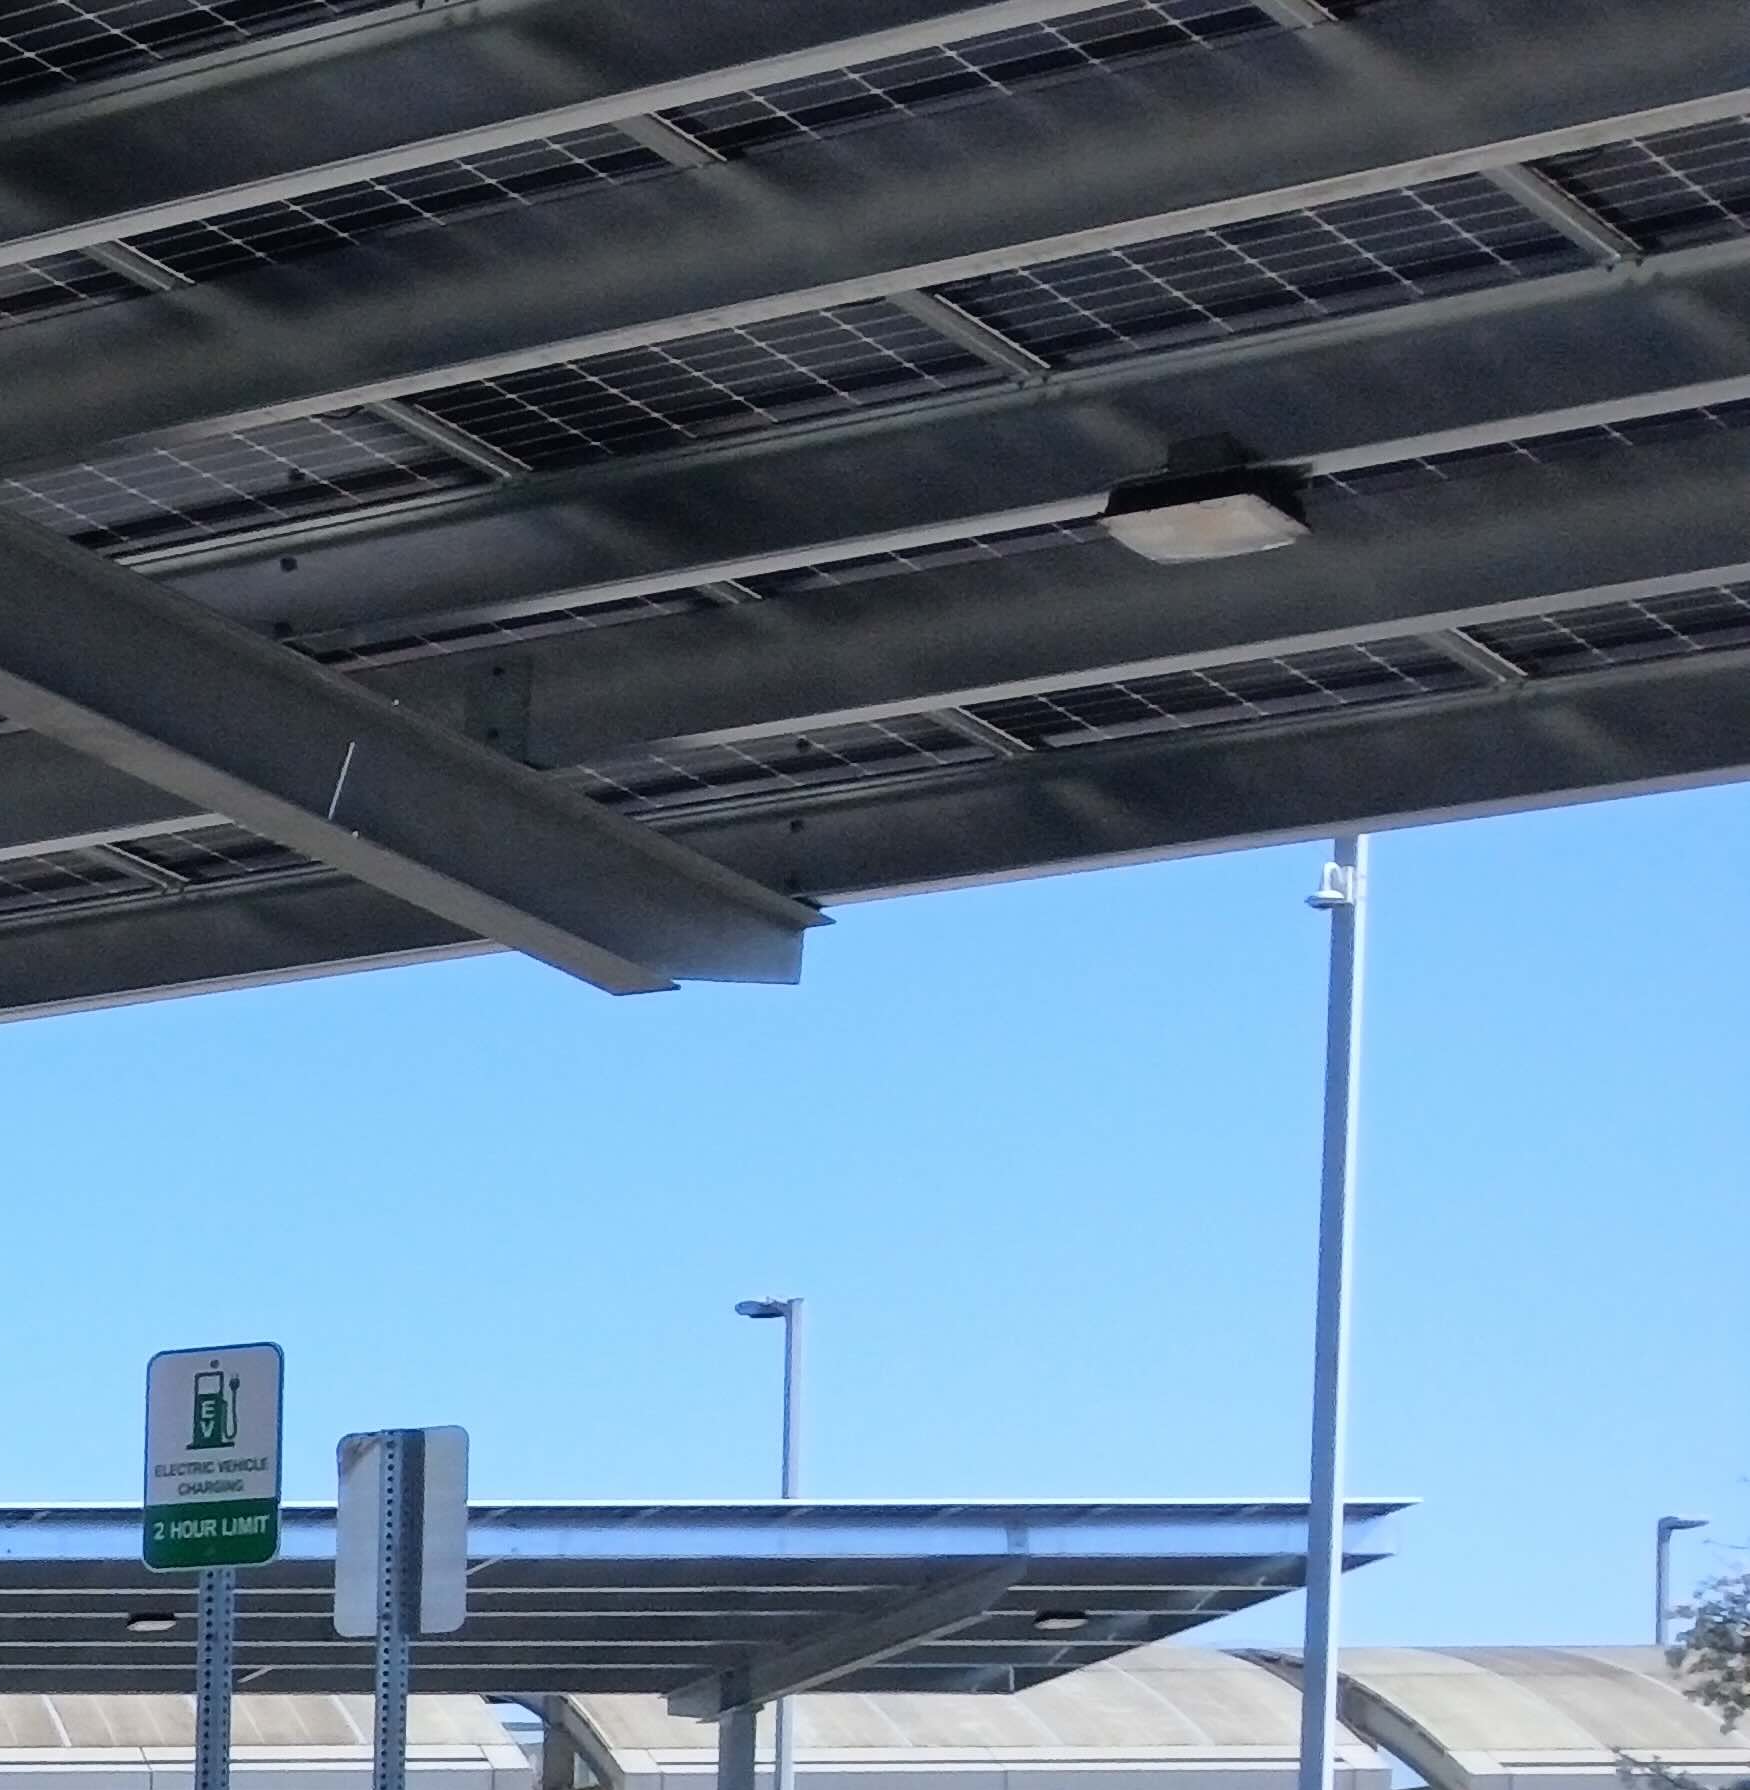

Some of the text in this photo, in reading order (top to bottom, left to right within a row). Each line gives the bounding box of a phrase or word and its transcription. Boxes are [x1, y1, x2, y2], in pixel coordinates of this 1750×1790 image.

[201, 1401, 216, 1438] EV
[154, 1457, 268, 1478] ELECTRIC VEHICLE
[177, 1480, 244, 1496] CHARGING
[153, 1515, 270, 1540] 2 HOUR LIMIT
